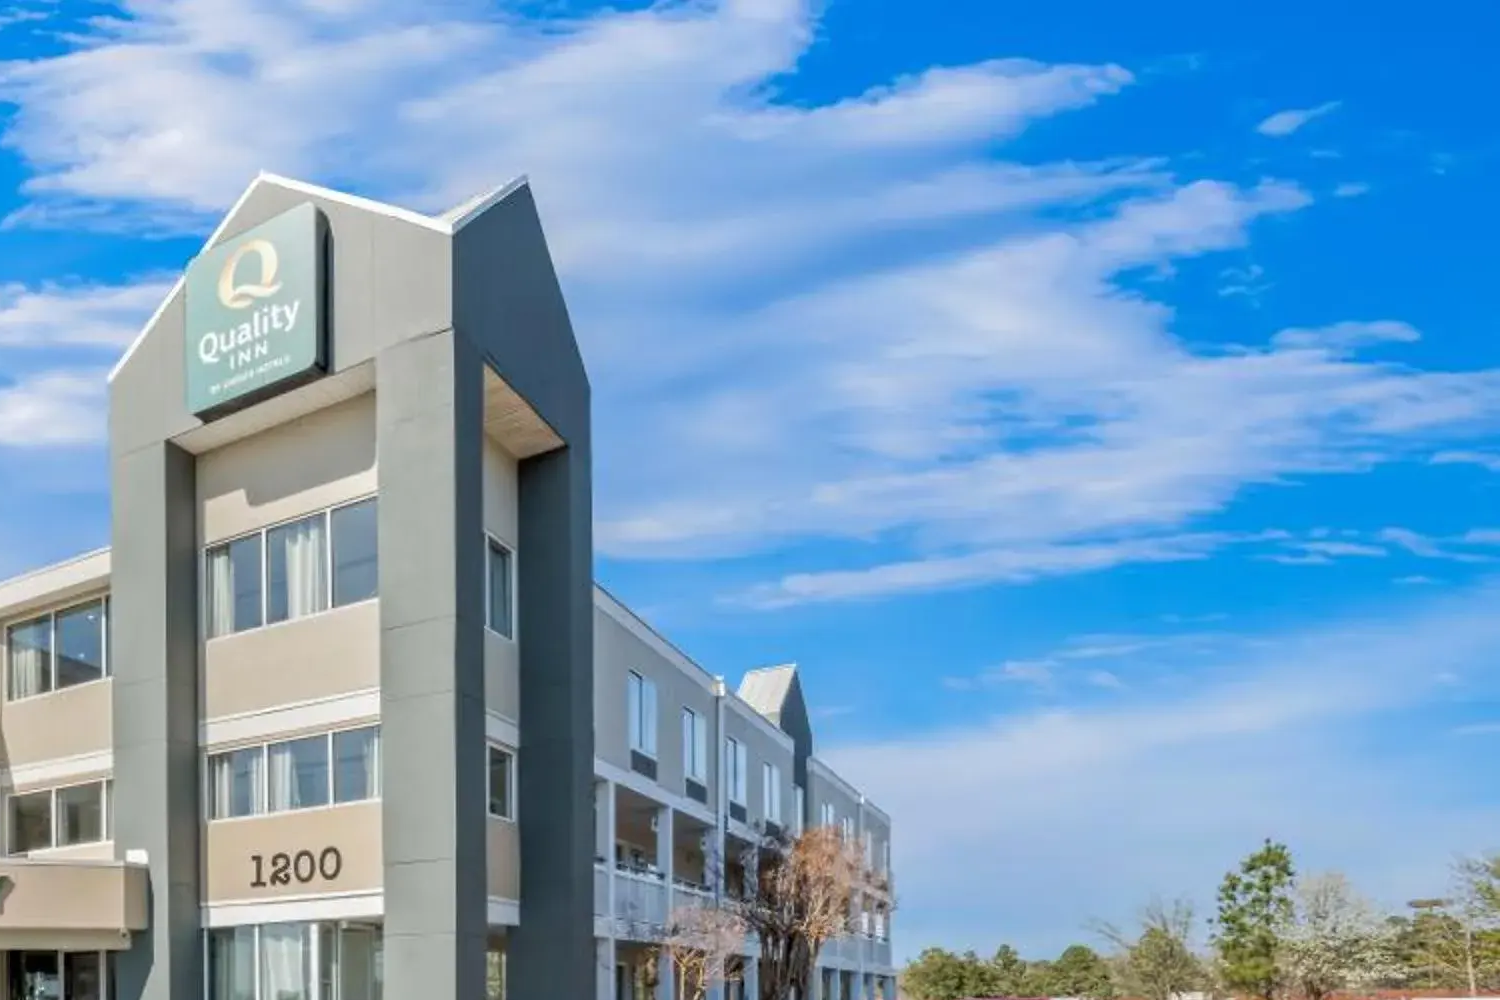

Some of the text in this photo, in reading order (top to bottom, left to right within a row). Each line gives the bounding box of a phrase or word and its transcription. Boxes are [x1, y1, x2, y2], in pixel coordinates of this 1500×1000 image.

[218, 239, 283, 309] Q
[198, 300, 300, 364] Quality
[230, 340, 268, 370] INN
[250, 846, 342, 887] 1200
